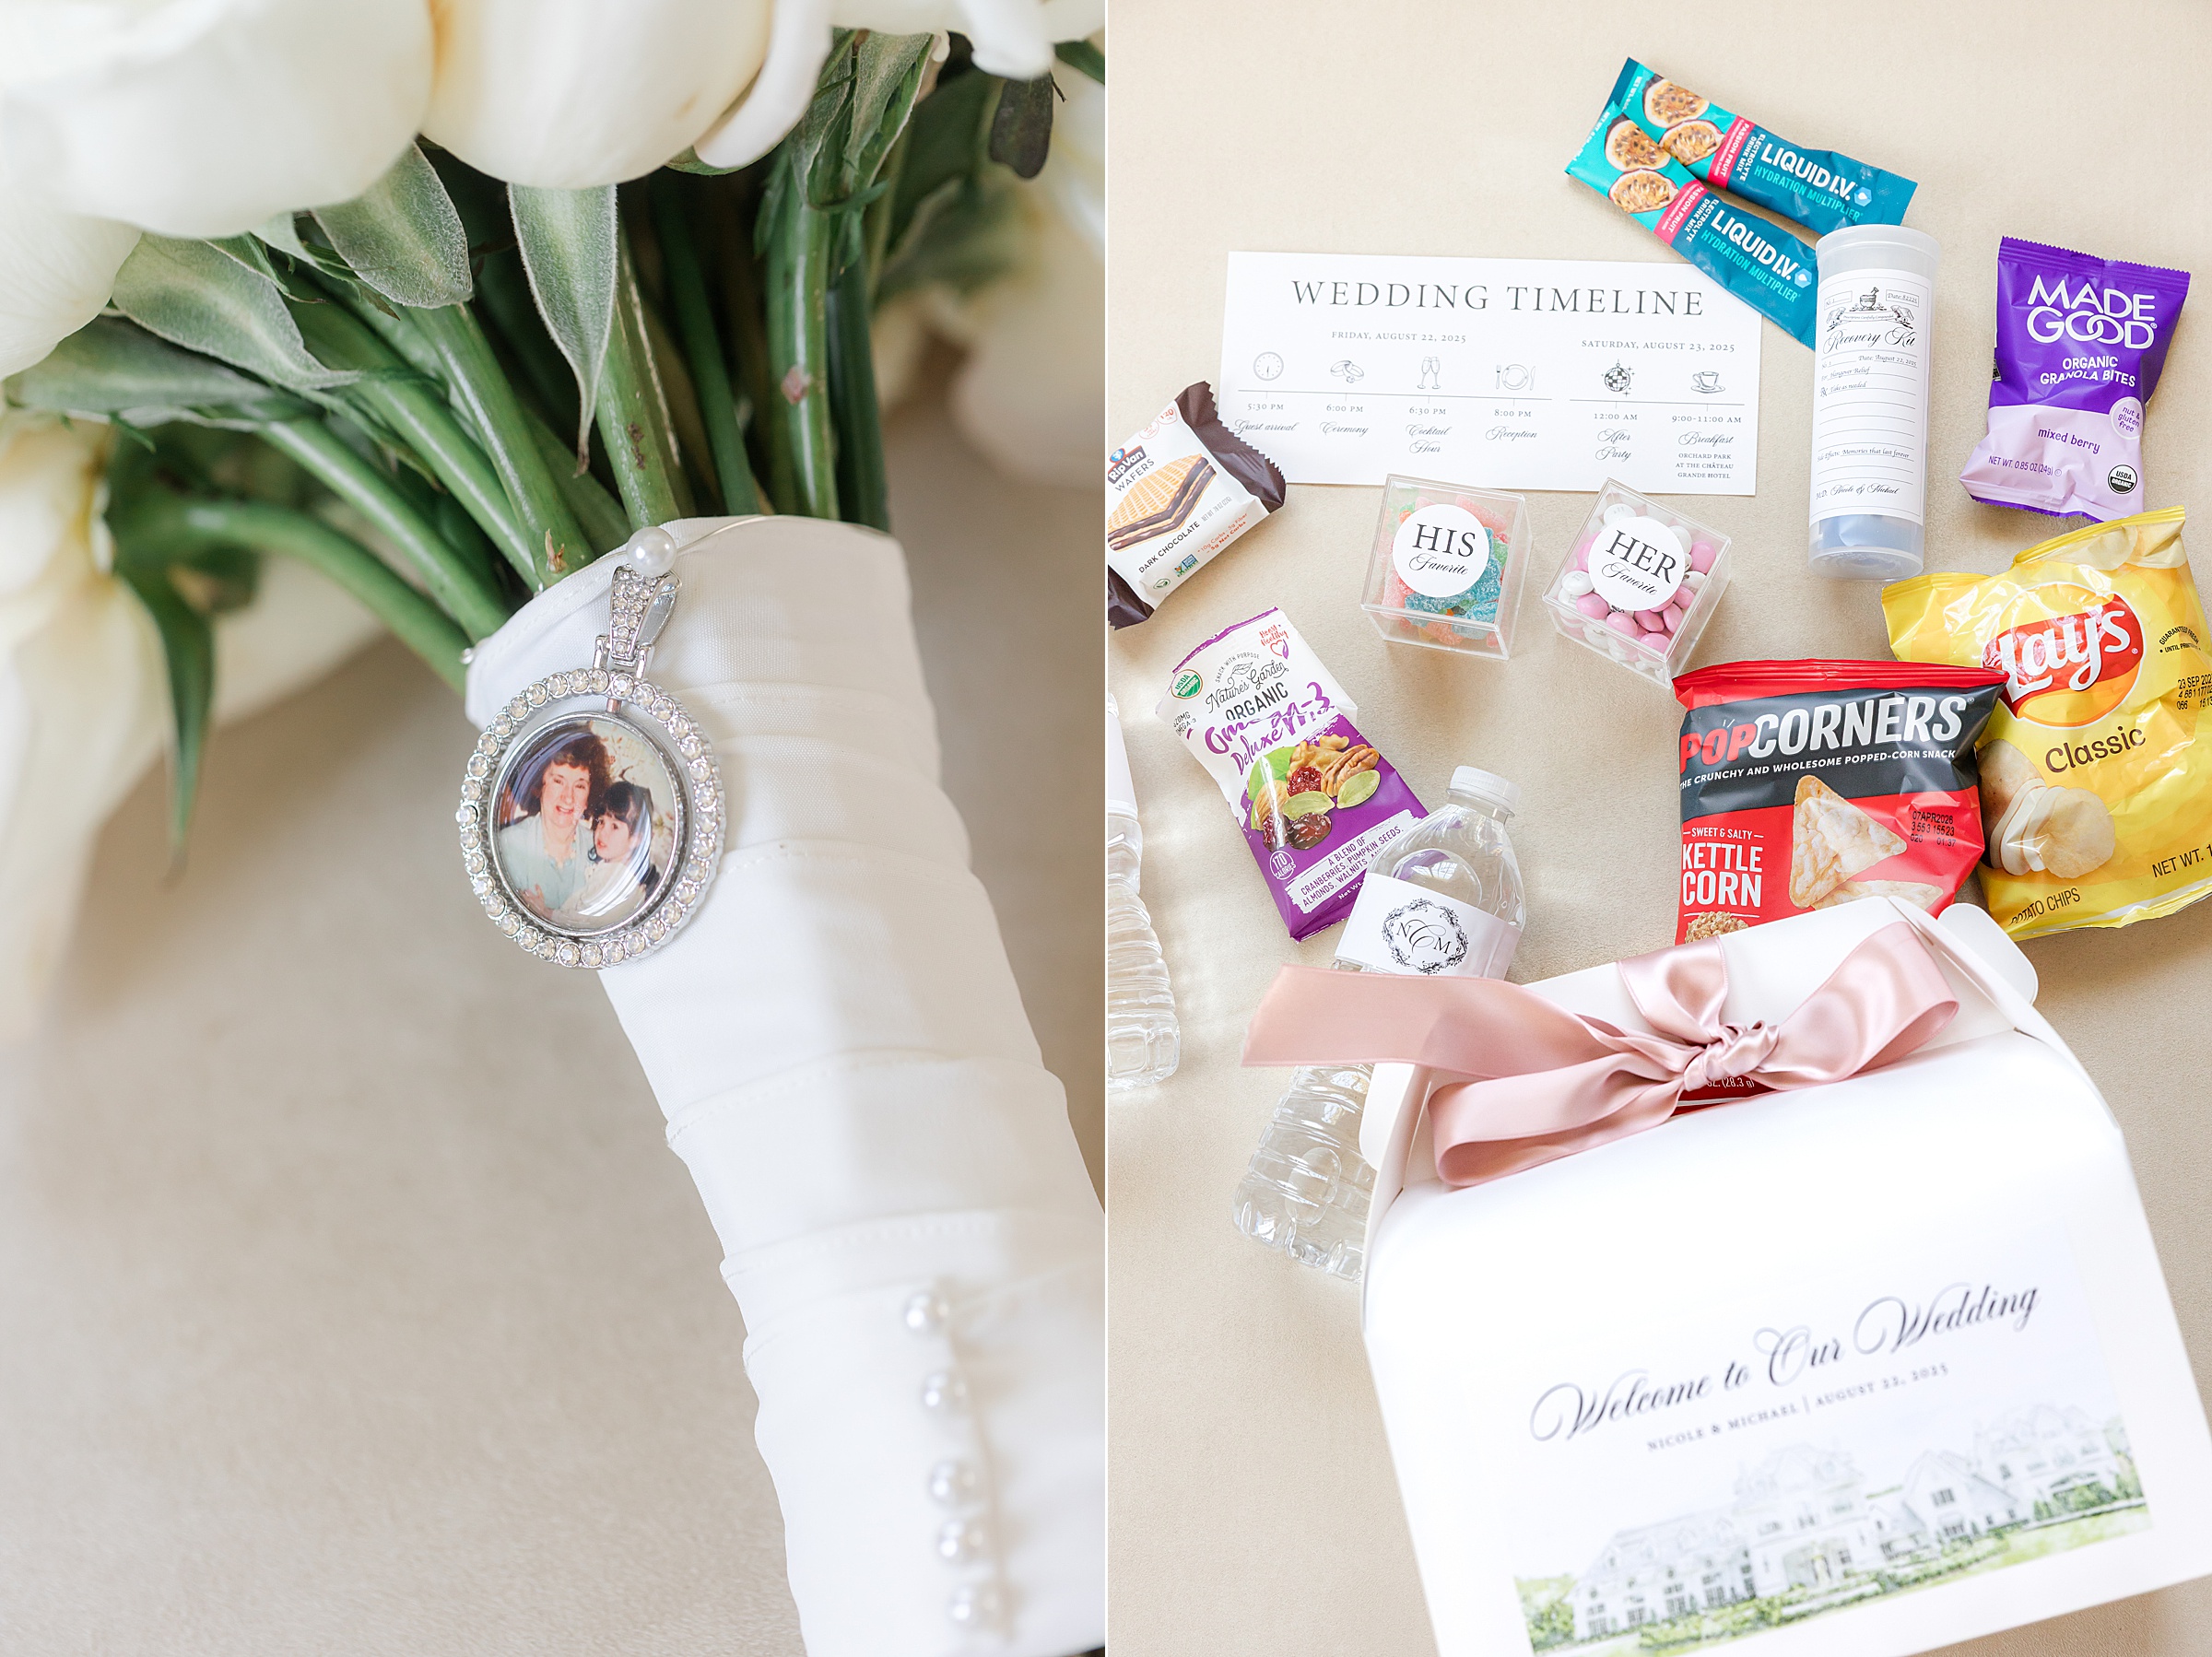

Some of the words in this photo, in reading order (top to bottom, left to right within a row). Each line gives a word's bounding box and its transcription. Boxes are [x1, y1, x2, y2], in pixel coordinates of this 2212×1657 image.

[1730, 123, 1750, 154] PASSION
[1743, 135, 1757, 158] DRINK
[1721, 154, 1734, 177] FRUIT
[1736, 158, 1747, 172] MIX
[1739, 134, 1766, 182] ELECTROLYTE
[1760, 143, 1831, 188] LIQUID
[1681, 186, 1704, 212] PASSION
[1754, 165, 1807, 196] HYDRATION
[1806, 189, 1861, 222] MULTIPLIER
[1694, 198, 1711, 219] DRINK
[1668, 211, 1684, 233] FRUIT
[1684, 218, 1696, 232] MIX
[1686, 199, 1720, 242] ELECTROLYTE
[1711, 209, 1777, 265] LIQUID
[1701, 229, 1751, 271] HYDRATION
[1748, 264, 1798, 303] MULTIPLIER
[1291, 280, 1488, 310] WEDDING
[1507, 286, 1703, 316] TIMELINE
[2027, 275, 2156, 322] MADE
[2027, 305, 2156, 350] GOOD
[1332, 331, 1371, 341] FRIDAY,
[1376, 333, 1418, 341] AUGUST
[1421, 334, 1437, 342] 22,
[1441, 335, 1466, 344] 2025
[1582, 340, 1639, 350] SATURDAY,
[1642, 342, 1685, 350] AUGUST
[1689, 343, 1706, 352] 23,
[1709, 343, 1735, 353] 2025
[1823, 328, 1881, 354] Recovery
[1885, 327, 1917, 348] Kit
[1853, 367, 1871, 375] Relief
[1905, 358, 1917, 367] 2025
[2062, 355, 2119, 370] ORGANIC
[1848, 381, 1867, 389] needed
[2040, 370, 2099, 385] GRANOLA
[2102, 369, 2136, 388] BITES
[1247, 403, 1267, 411] 5:30
[1326, 404, 1347, 413] 6:00
[1409, 406, 1430, 416] 6:30
[1494, 408, 1514, 417] 8:00
[1594, 412, 1619, 420] 12:00
[2123, 406, 2135, 417] nut
[1235, 418, 1263, 435] Guest
[1265, 422, 1300, 431] arrival
[1672, 415, 1724, 423] 9:00-11:00
[2117, 414, 2140, 427] gluten
[2119, 420, 2135, 432] free
[1320, 421, 1370, 437] Ceremony
[1406, 424, 1453, 437] Cocktail
[1486, 426, 1537, 441] Reception
[1597, 428, 1631, 442] After
[1408, 439, 1442, 454] Hour
[1678, 430, 1735, 447] Breakfast
[2038, 429, 2068, 443] mixed
[2070, 434, 2100, 454] berry
[1595, 445, 1632, 463] Party
[1883, 447, 1892, 455] last
[1892, 450, 1910, 458] forever
[1701, 462, 1734, 470] CHÂTEAU
[1988, 455, 2001, 466] NET
[2002, 458, 2014, 468] WT.
[2014, 460, 2029, 471] 0.85
[2030, 463, 2038, 472] OZ
[2038, 464, 2053, 476] (24g)
[1115, 458, 1155, 492] WAFERS
[2112, 477, 2133, 488] ORGANIC
[2116, 470, 2132, 481] USDA
[1830, 484, 1854, 496] Nicole
[1867, 483, 1900, 495] Michael
[1211, 532, 1226, 544] Carbs
[1235, 513, 1247, 524] Fiber
[1230, 522, 1246, 535] Carbs
[1138, 555, 1159, 573] DARK
[1158, 521, 1200, 558] CHOCOLATE
[1412, 523, 1477, 558] HIS
[1408, 554, 1469, 576] Favorite
[1605, 529, 1677, 584] HER
[1602, 561, 1658, 595] Favorite
[2164, 644, 2180, 652] UNTIL
[1215, 666, 1225, 683] SNACK
[1224, 656, 1236, 666] WITH
[1237, 652, 1260, 660] PURPOSE
[1175, 674, 1191, 690] USDA
[1206, 677, 1250, 713] Nature's
[1246, 660, 1289, 690] Garden
[2178, 678, 2186, 689] 23
[2187, 676, 2200, 687] SEP
[1225, 682, 1288, 721] ORGANIC
[2176, 700, 2188, 711] 066
[1680, 696, 1967, 774] POPCORNERS
[1230, 727, 1284, 776] Deluxe
[2045, 725, 2147, 773] Classic
[1694, 769, 1745, 784] CRUNCHY
[1747, 766, 1770, 776] AND
[1772, 757, 1842, 772] WHOLESOME
[1844, 750, 1921, 765] POPPED-CORN
[1922, 749, 1956, 758] SNACK
[1912, 811, 1954, 825] 07APR2026
[1691, 828, 1718, 838] SWEET
[1720, 828, 1725, 838] &
[1727, 828, 1753, 840] SALTY
[1911, 833, 1924, 843] 020
[1936, 837, 1956, 847] 01:37
[1334, 843, 1357, 862] BLEND
[1357, 836, 1366, 849] OF
[1347, 842, 1379, 864] PUMPKIN
[1682, 842, 1763, 873] KETTLE
[1272, 852, 1287, 869] 170
[2152, 856, 2177, 878] NET
[2180, 848, 2205, 868] WT.
[1276, 863, 1296, 879] CALORIES
[1335, 858, 1369, 884] WALNUTS
[1337, 889, 1352, 900] Net
[1682, 870, 1762, 908] CORN
[2008, 899, 2045, 926] POTATO
[2046, 887, 2081, 911] CHIPS
[1722, 1077, 1745, 1089] (28.3
[1529, 1369, 1712, 1442] Welcome
[1724, 1359, 1751, 1389] to
[1752, 1325, 1846, 1387] Our
[1853, 1282, 2040, 1356] Wedding
[1647, 1427, 1706, 1452] NICOLE
[1711, 1422, 1723, 1436] &
[1727, 1403, 1800, 1431] MICHAEL
[1814, 1381, 1877, 1407] AUGUST
[1882, 1374, 1909, 1390] 22,
[1912, 1362, 1950, 1381] 2025
